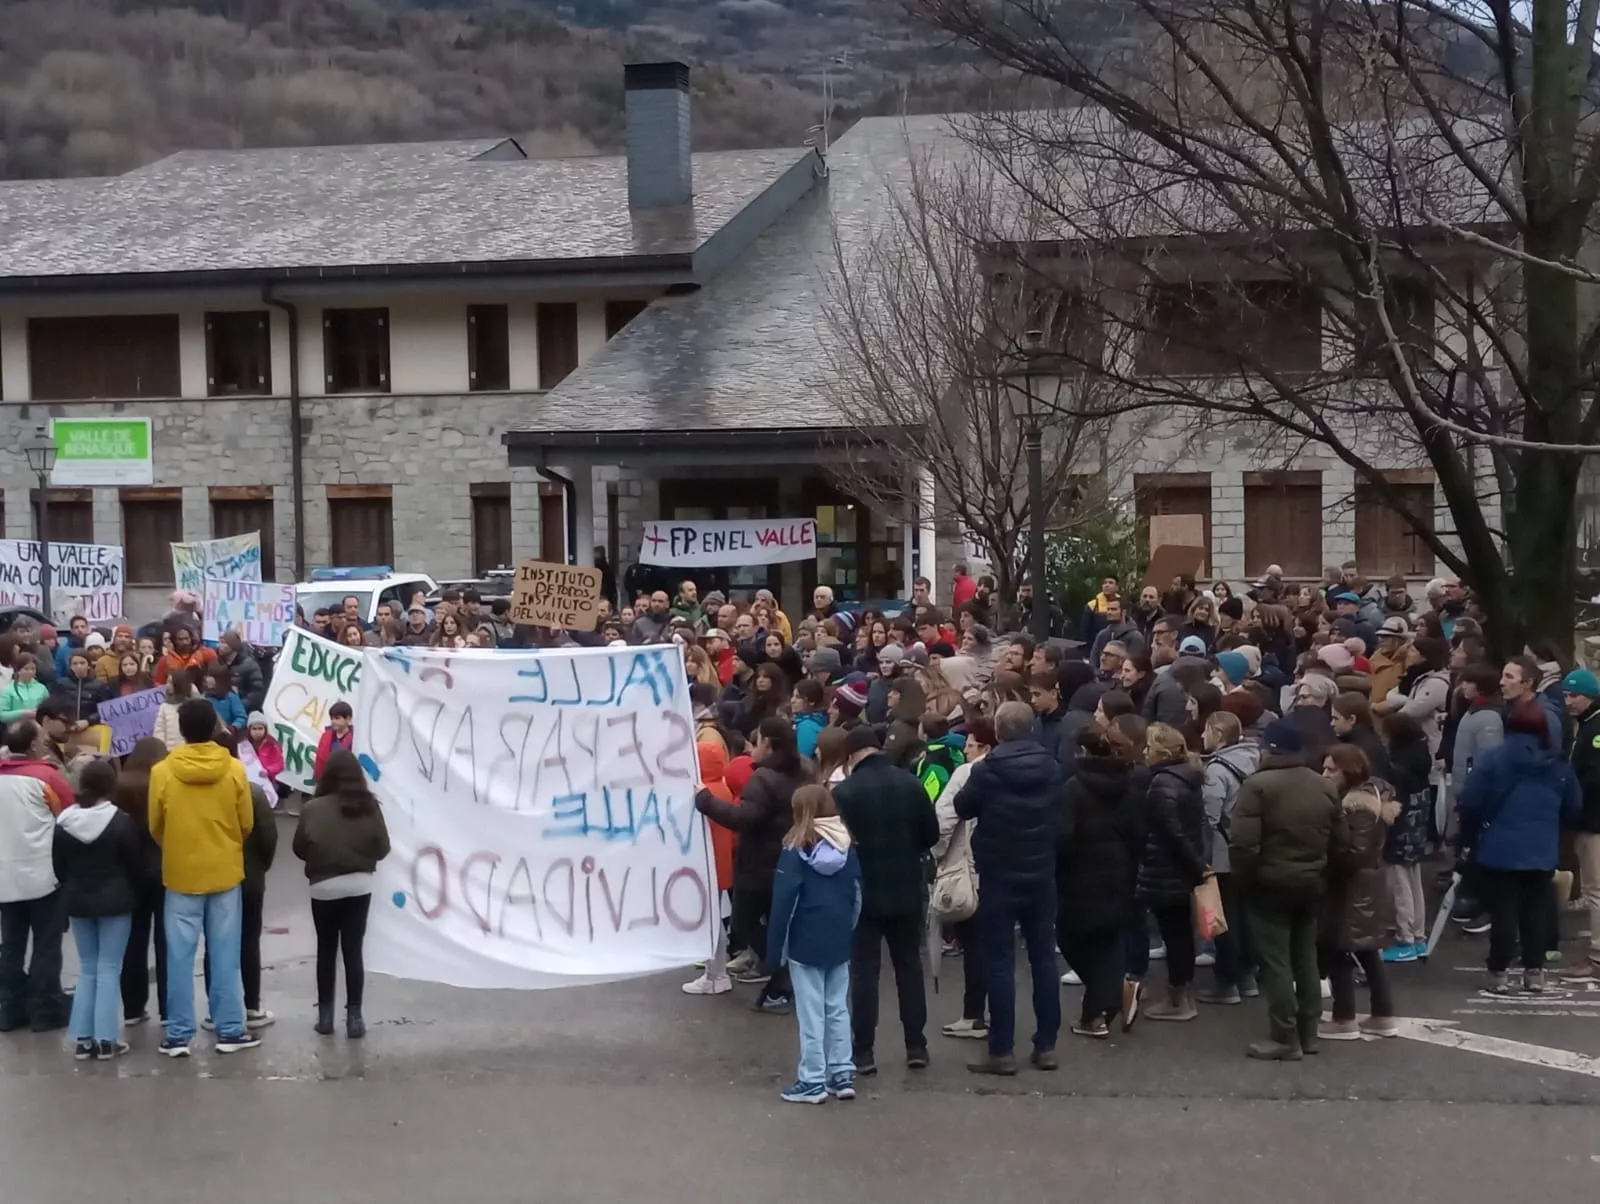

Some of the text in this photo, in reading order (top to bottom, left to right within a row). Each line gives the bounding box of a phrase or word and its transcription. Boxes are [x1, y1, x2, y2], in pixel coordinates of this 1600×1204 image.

[755, 520, 813, 547] VALLE
[17, 542, 108, 566] UN VALLE
[521, 566, 595, 588] INSTITUTO
[205, 600, 295, 623] HAEMOS
[520, 592, 592, 611] INSTITUTO
[513, 607, 534, 619] DEL
